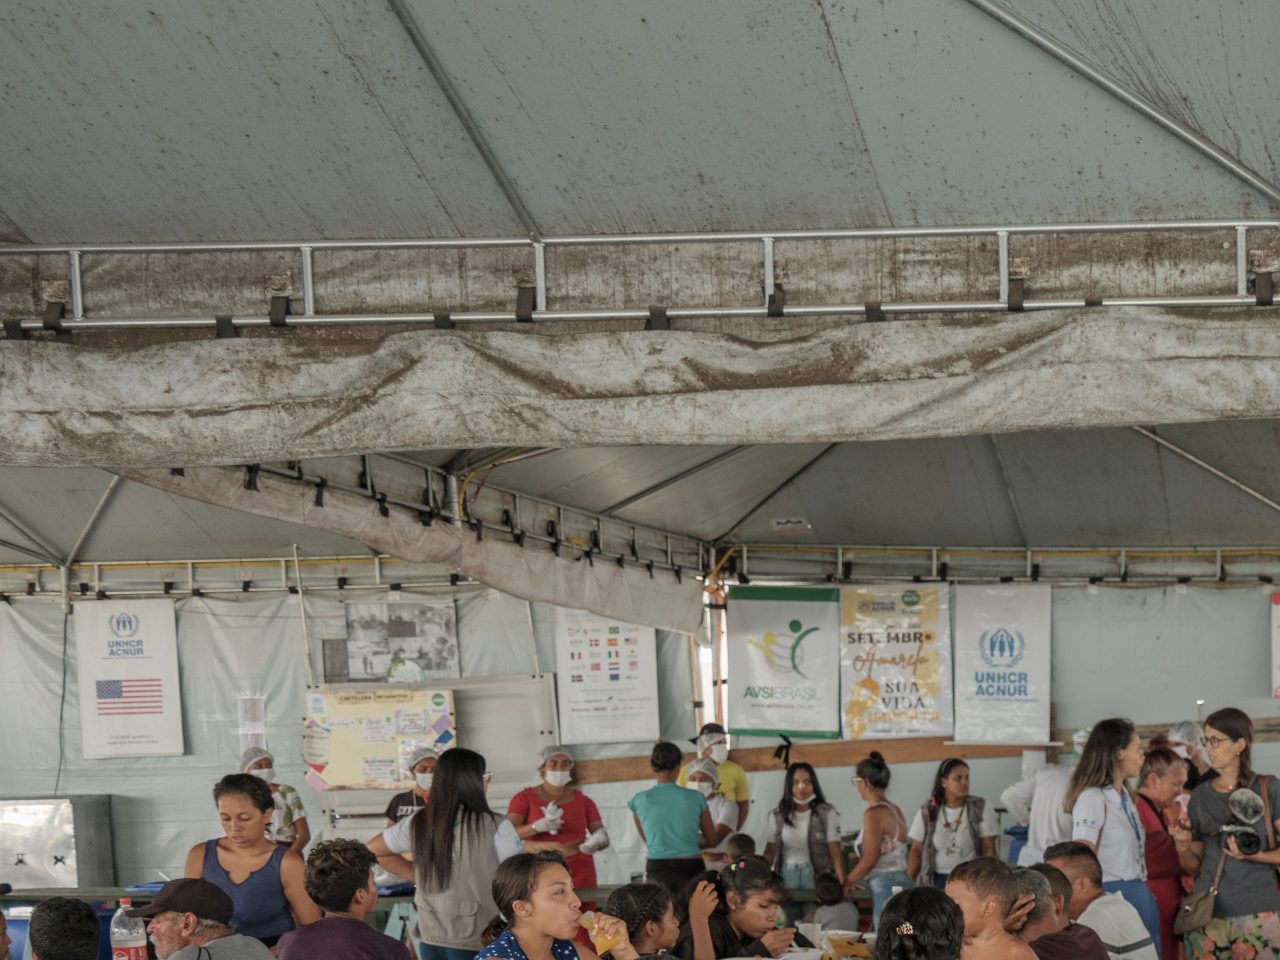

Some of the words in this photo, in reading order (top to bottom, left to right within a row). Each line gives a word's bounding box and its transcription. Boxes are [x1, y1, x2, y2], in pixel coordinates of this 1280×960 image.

[107, 639, 144, 648] UNHCR
[108, 648, 145, 657] ACNUR
[975, 672, 1028, 683] UNHCR
[975, 684, 1028, 696] ACNUR
